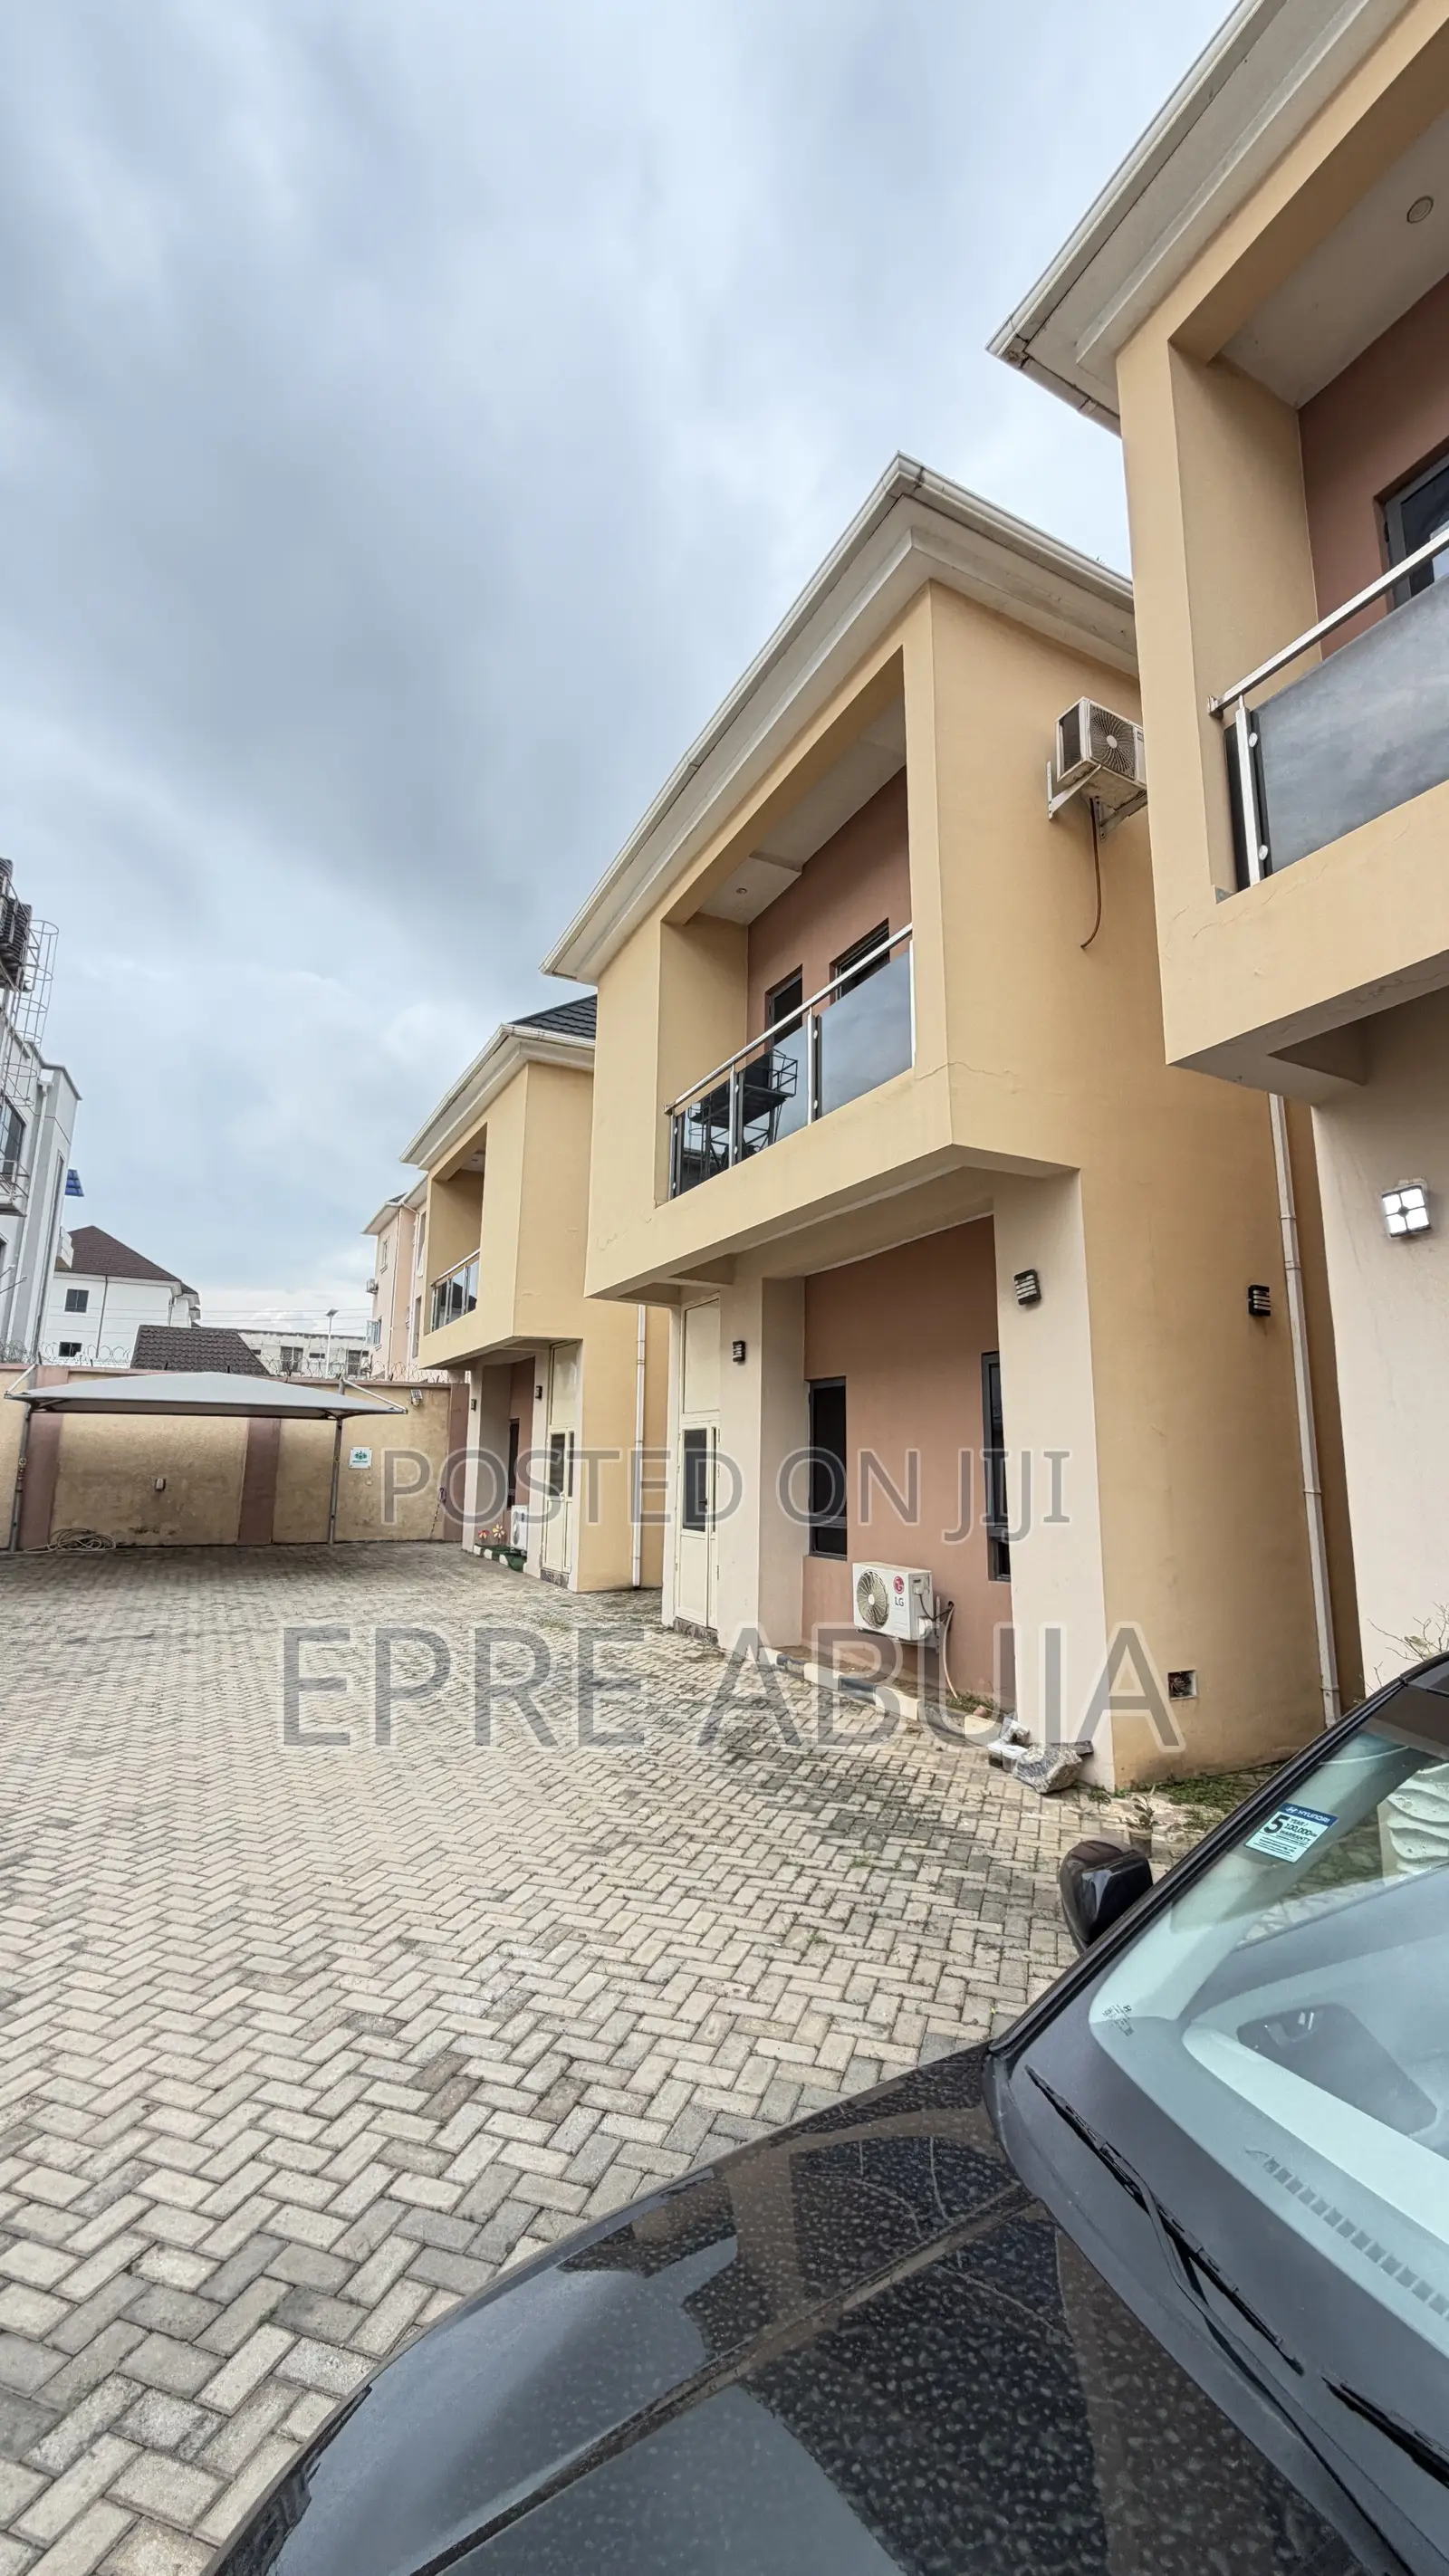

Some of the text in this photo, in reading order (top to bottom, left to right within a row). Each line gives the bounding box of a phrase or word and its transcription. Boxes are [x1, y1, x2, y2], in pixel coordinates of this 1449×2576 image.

[894, 1596, 905, 1607] LG
[1297, 1810, 1330, 1823] HYUNDAI
[1263, 1814, 1291, 1834] 5
